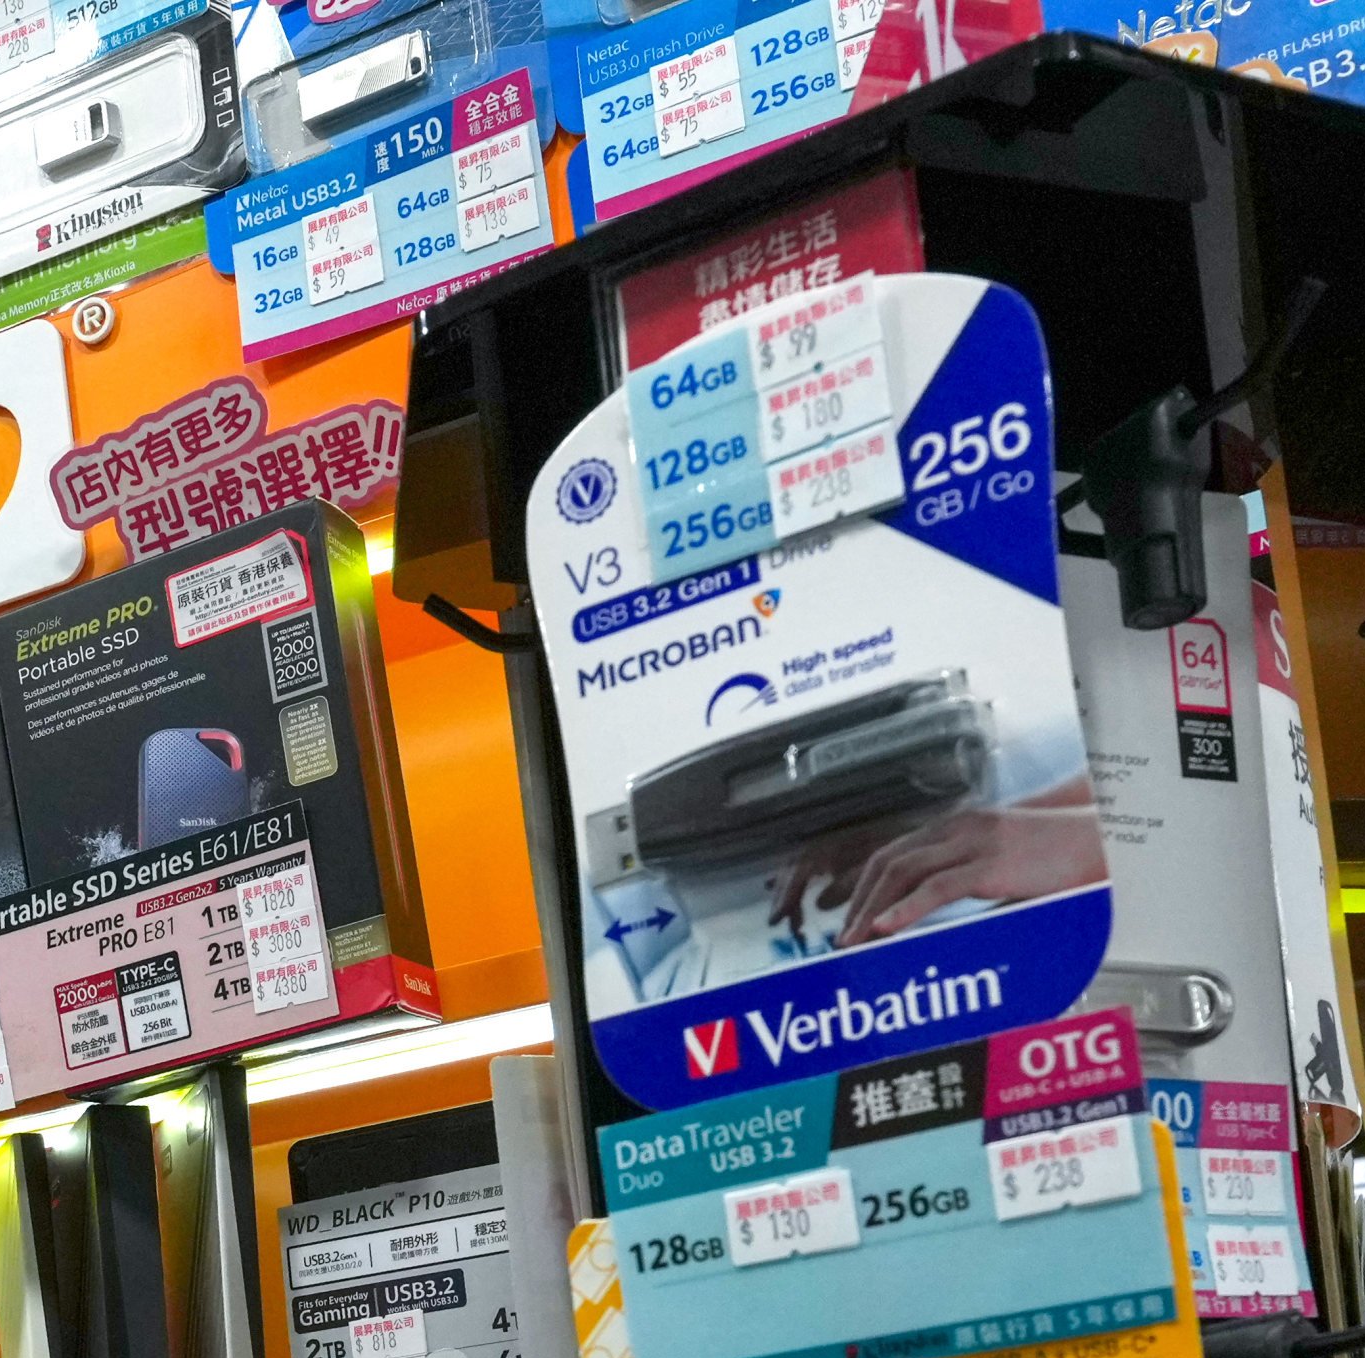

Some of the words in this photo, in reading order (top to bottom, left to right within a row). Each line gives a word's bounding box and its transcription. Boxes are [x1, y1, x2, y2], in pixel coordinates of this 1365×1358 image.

[587, 38, 630, 66] Netac
[588, 54, 640, 85] USB3.0
[643, 36, 682, 67] Flash
[686, 20, 726, 52] Drive
[465, 84, 520, 119] 全合金
[390, 117, 444, 159] 150
[55, 190, 143, 245] Kingston
[237, 206, 289, 231] Metal
[292, 173, 358, 215] USB3.2
[251, 184, 289, 207] Netac
[394, 234, 456, 266] 128GB
[694, 209, 839, 297] 精彩生活
[66, 394, 252, 511] 店內有更多
[909, 403, 1032, 491] 256
[661, 498, 774, 557] 256GB
[177, 577, 234, 609] 原裝行貨
[237, 553, 295, 590] 香港保養
[565, 546, 623, 594] V3
[580, 602, 629, 637] USB
[635, 583, 672, 616] 3.2
[677, 567, 730, 604] Gen
[741, 561, 752, 581] 1
[16, 615, 100, 662] Extreme
[105, 596, 153, 628] PRO
[272, 636, 315, 659] 2000
[783, 647, 824, 677] High
[833, 627, 894, 664] speed
[784, 670, 821, 696] data
[826, 648, 896, 684] transfer
[199, 813, 295, 866] E61/E81
[72, 865, 119, 910] SSD
[122, 843, 194, 890] Series
[243, 873, 304, 900] 展昇有限公司
[745, 967, 1004, 1066] Verbatim
[1020, 1023, 1122, 1078] OTG
[287, 1199, 395, 1236] WD_BLACK
[409, 1189, 444, 1214] P10
[862, 1184, 971, 1228] 256GB
[299, 1302, 370, 1328] Gaming
